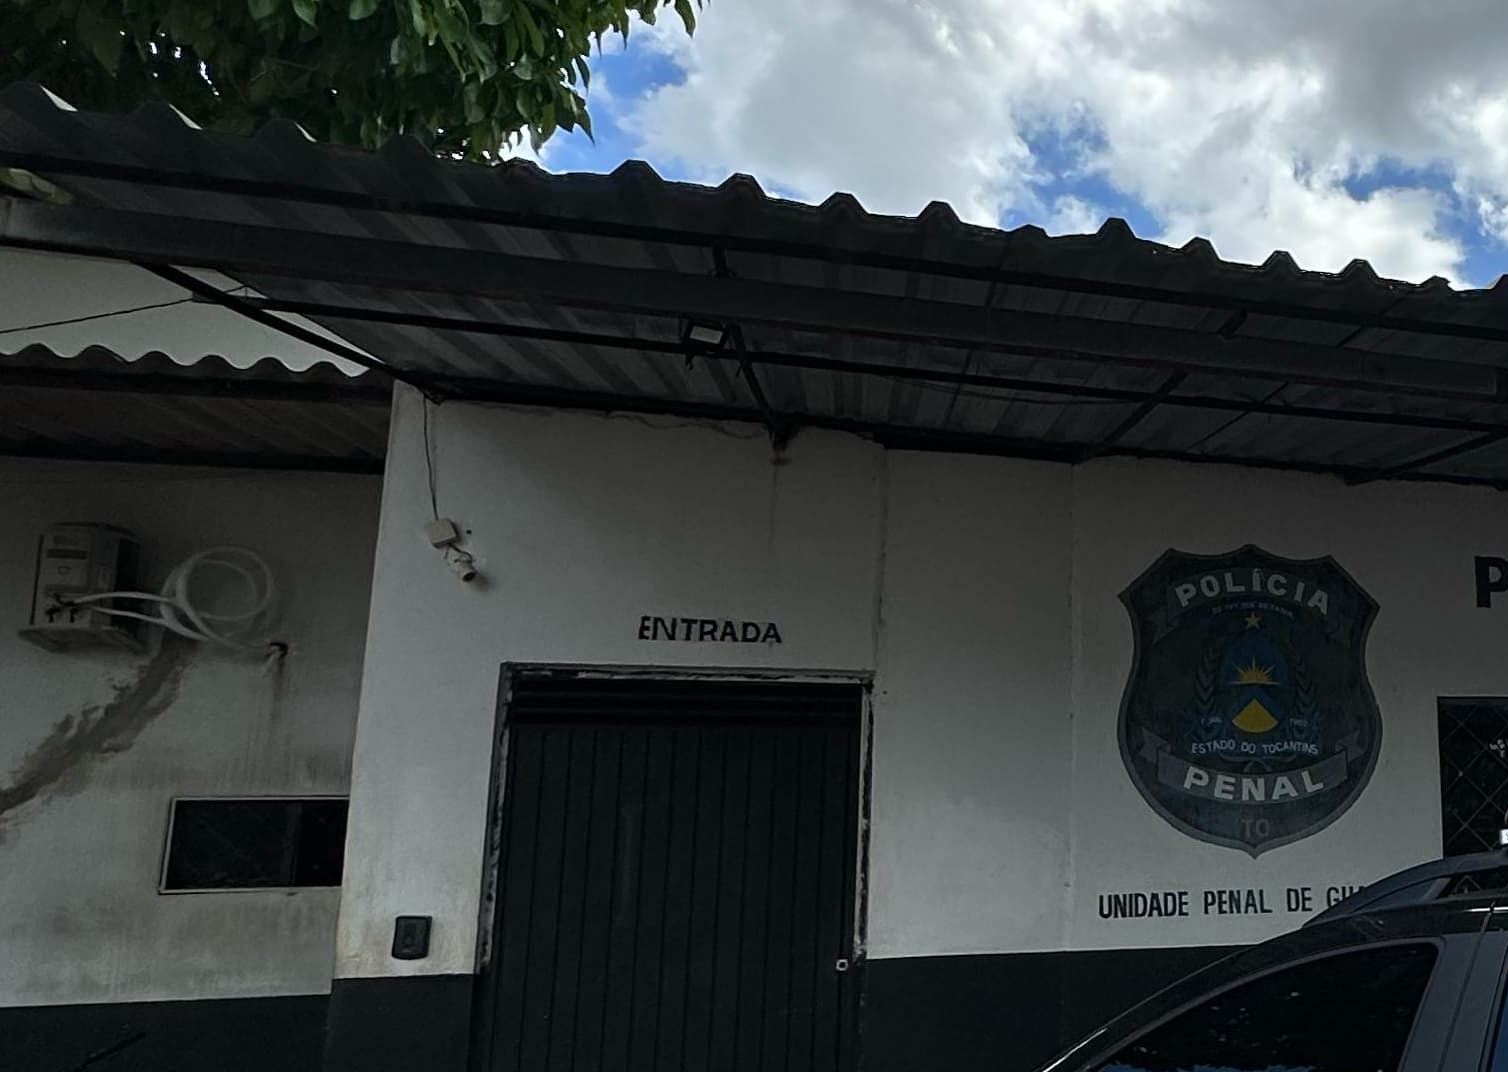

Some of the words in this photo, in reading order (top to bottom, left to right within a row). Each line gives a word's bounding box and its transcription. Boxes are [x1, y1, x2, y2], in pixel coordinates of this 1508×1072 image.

[1175, 568, 1329, 615] POLÍCIA
[638, 615, 782, 643] ENTRADA
[1191, 738, 1236, 754] ESTADO
[1241, 741, 1256, 754] DO
[1261, 740, 1319, 755] TOCANTINS
[1183, 766, 1324, 800] PENAL
[1241, 817, 1270, 839] TO
[1098, 891, 1189, 919] UNIDADE
[1203, 889, 1273, 915] PENAL
[1286, 887, 1313, 912] DE
